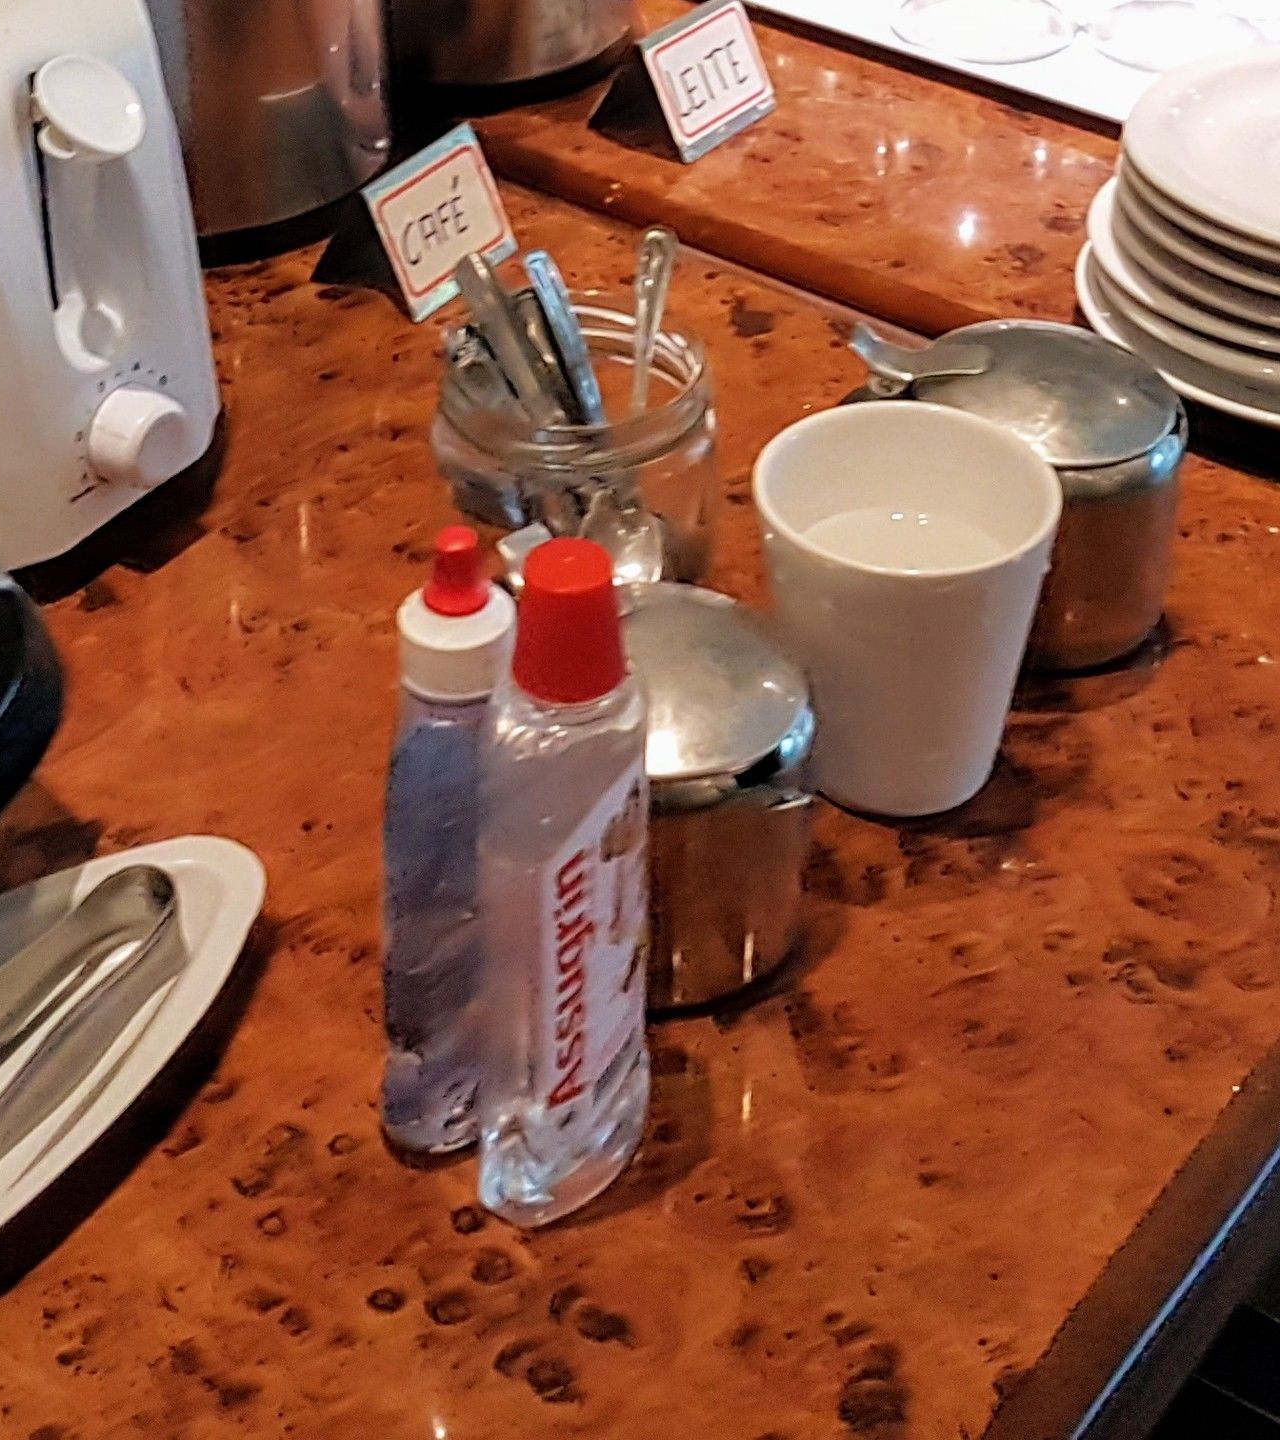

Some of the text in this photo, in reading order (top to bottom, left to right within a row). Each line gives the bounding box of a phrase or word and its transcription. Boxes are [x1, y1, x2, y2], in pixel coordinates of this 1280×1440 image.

[665, 39, 749, 117] LEITE
[401, 175, 469, 266] CAFÉ
[547, 846, 596, 1110] Assugrin
